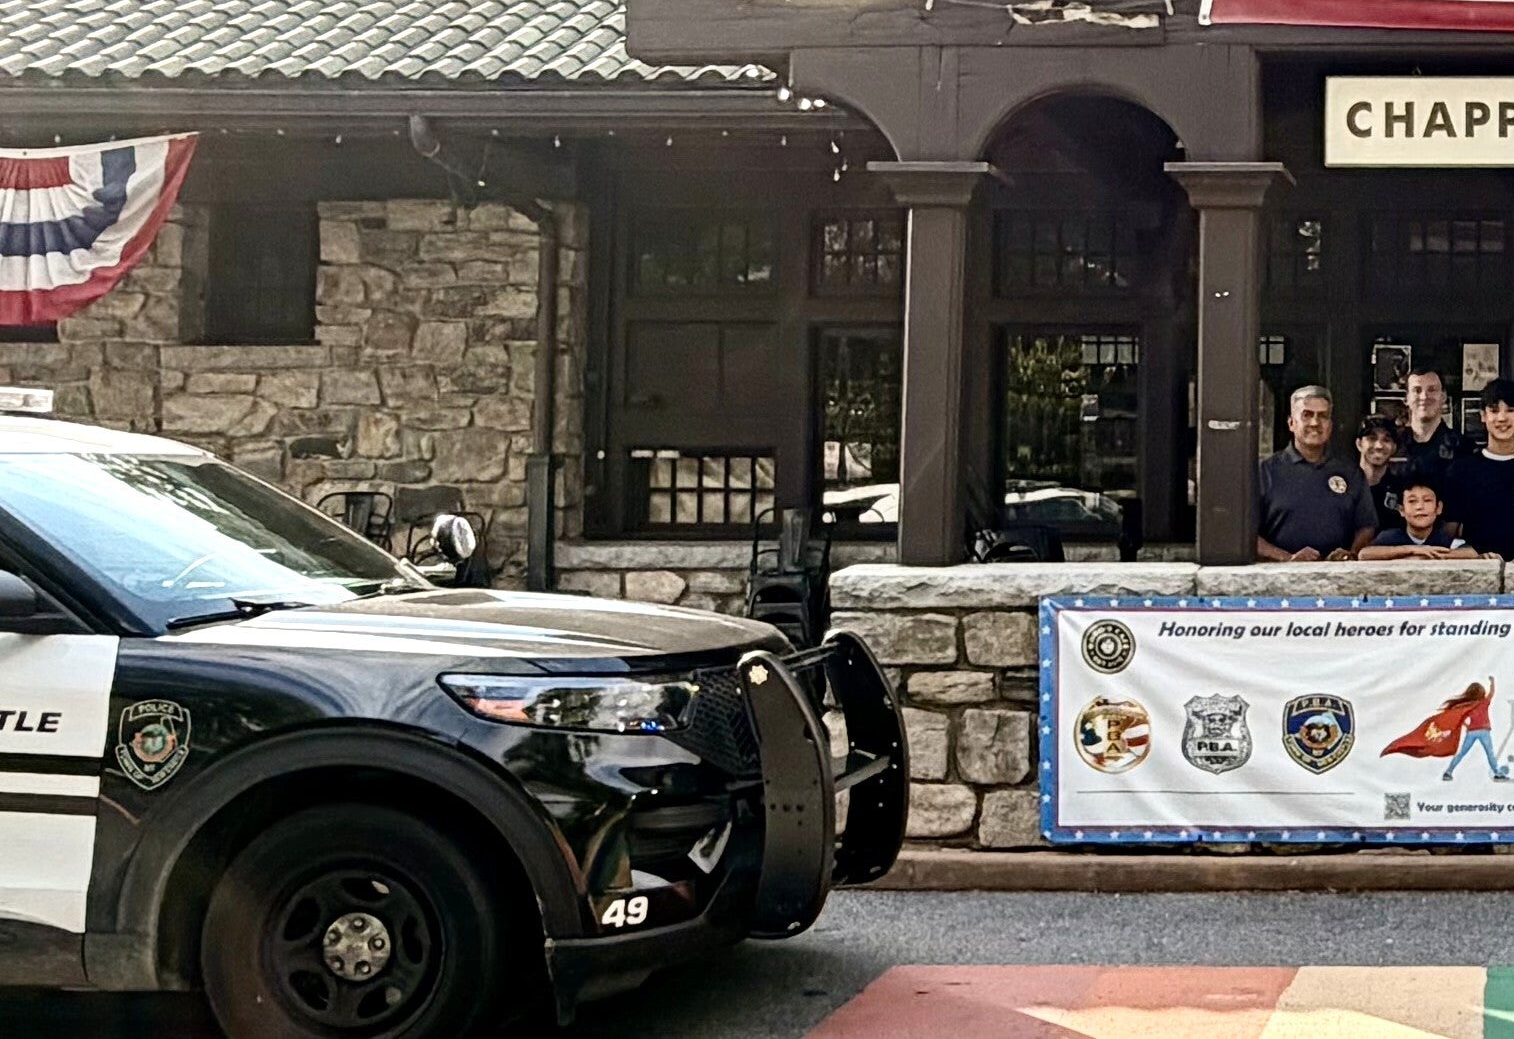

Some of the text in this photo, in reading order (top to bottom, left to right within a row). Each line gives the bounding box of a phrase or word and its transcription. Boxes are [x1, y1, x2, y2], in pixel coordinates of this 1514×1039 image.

[1158, 621, 1246, 639] Honoring
[1250, 625, 1282, 637] our
[1286, 621, 1331, 637] local
[1334, 621, 1394, 637] heroes
[1399, 620, 1427, 636] for
[1430, 620, 1511, 637] standing
[138, 703, 175, 713] POLICE
[1417, 801, 1443, 812] Your
[1447, 802, 1504, 814] generosity
[601, 895, 649, 928] 49
